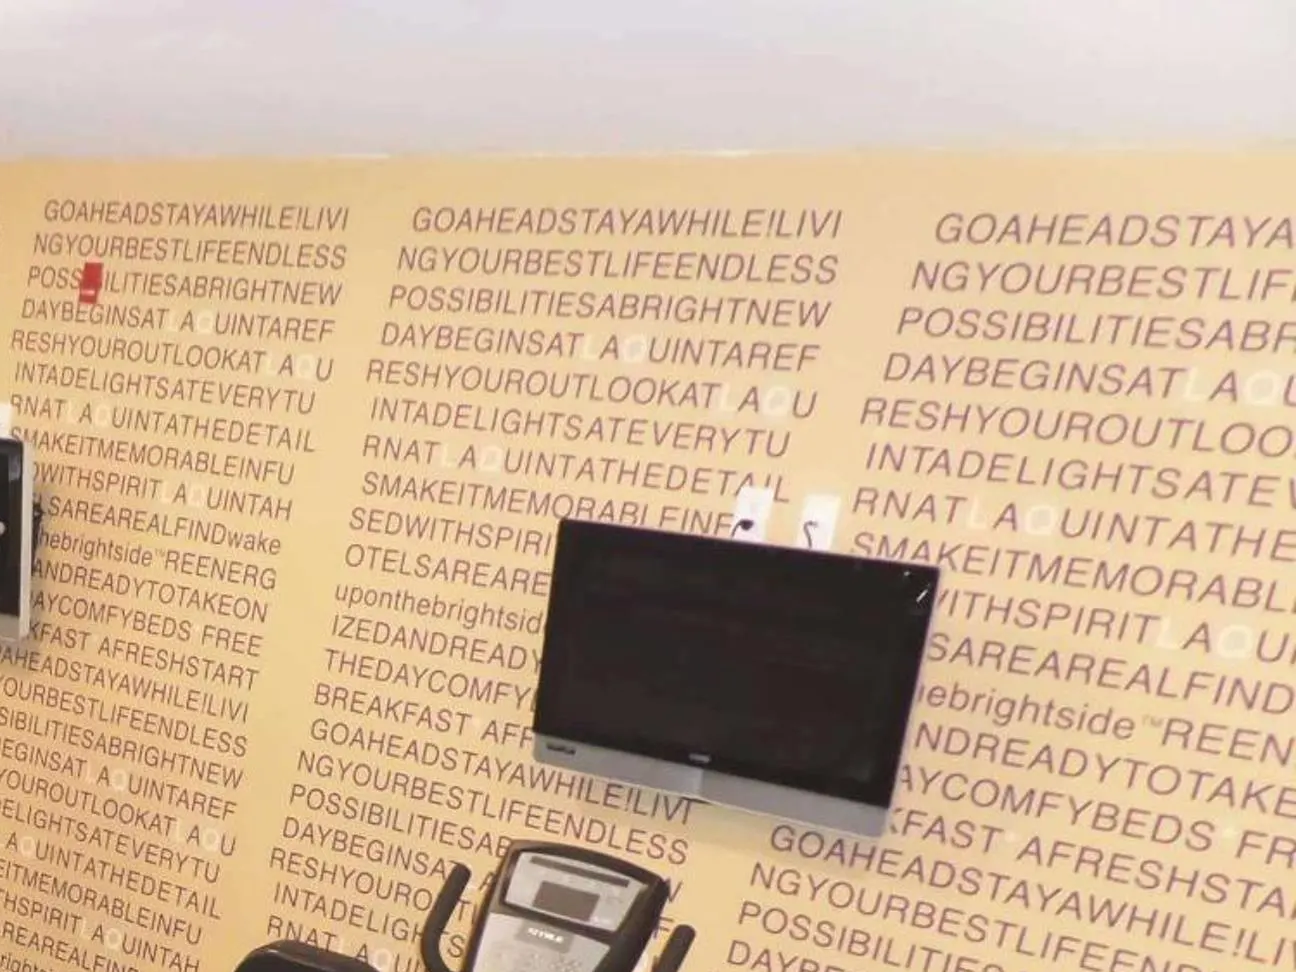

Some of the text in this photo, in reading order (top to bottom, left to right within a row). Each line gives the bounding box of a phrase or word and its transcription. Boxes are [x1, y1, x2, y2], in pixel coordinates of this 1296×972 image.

[397, 243, 840, 288] NGYOURBESTLIFEENDLESS
[909, 260, 1296, 302] NGYOURBESTLIF
[387, 281, 831, 333] POSSIBILITIESABRIGHTNEW
[369, 395, 791, 464] INTADELIGHTSATEVERYTU
[864, 443, 1296, 515] INTADELIGHTSATE
[847, 532, 1296, 619] SMAKEITMEMORABL
[97, 634, 259, 691] AFRESHSTART
[200, 623, 263, 657] FREE
[313, 682, 471, 739] BREAKFAST
[296, 749, 689, 872] NGYOURBESTLIFEENDLESS
[1015, 836, 1296, 927] AFRESHSTA
